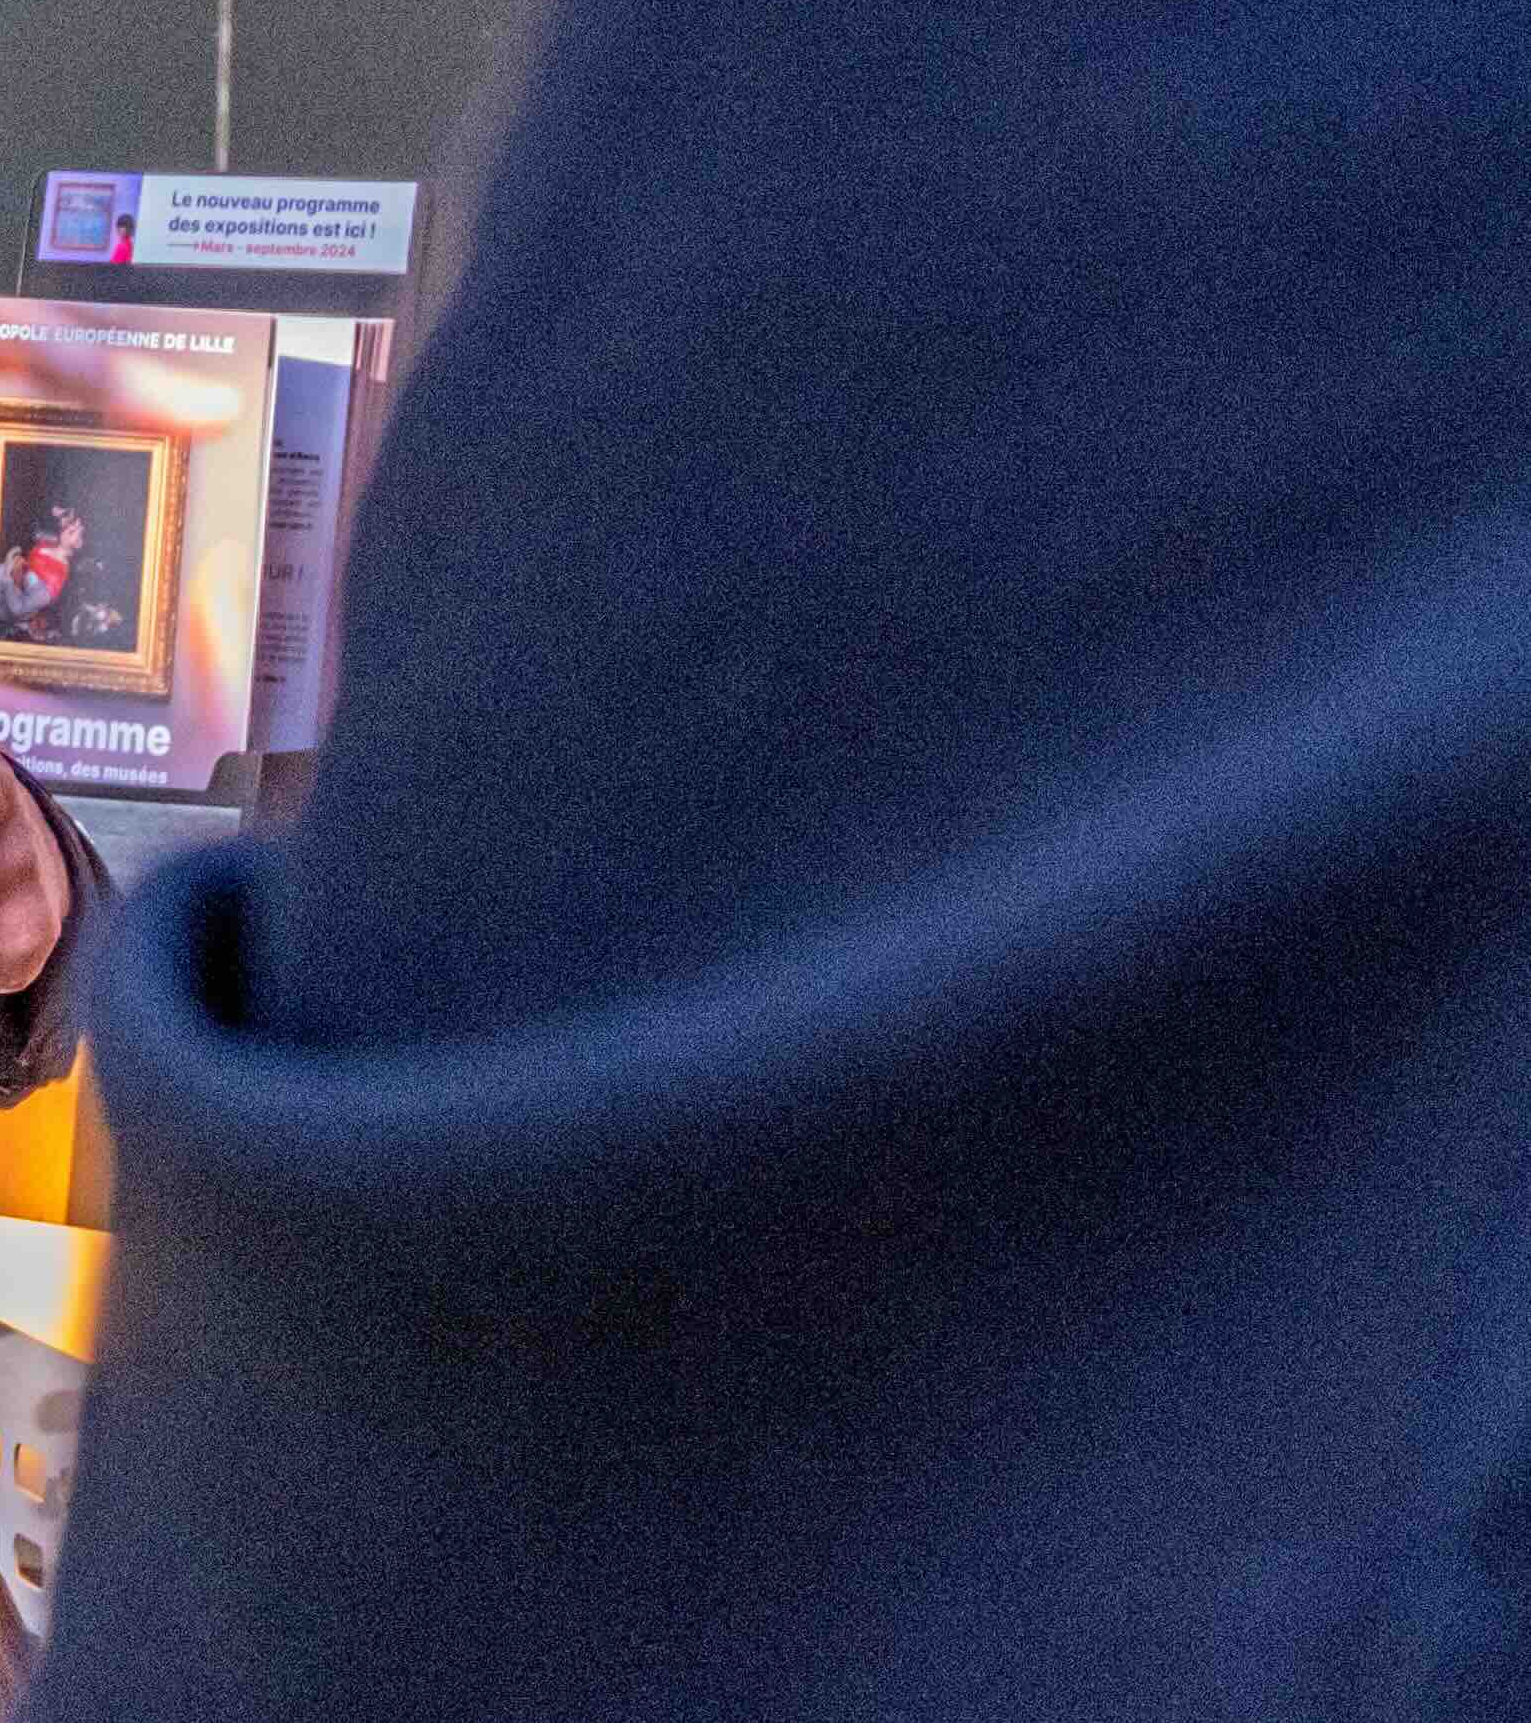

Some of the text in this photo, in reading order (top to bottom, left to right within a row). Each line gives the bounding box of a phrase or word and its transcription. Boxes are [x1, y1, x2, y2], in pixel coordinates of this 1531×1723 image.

[172, 191, 380, 216] Le nouveau programme
[169, 216, 200, 233] des
[205, 218, 308, 238] expositions
[312, 223, 340, 239] est
[344, 222, 366, 239] ici
[54, 324, 159, 350] EUROPÉENNE
[162, 332, 187, 352] DE
[190, 334, 236, 355] LILLE
[70, 760, 101, 777] des
[104, 765, 168, 784] musées
